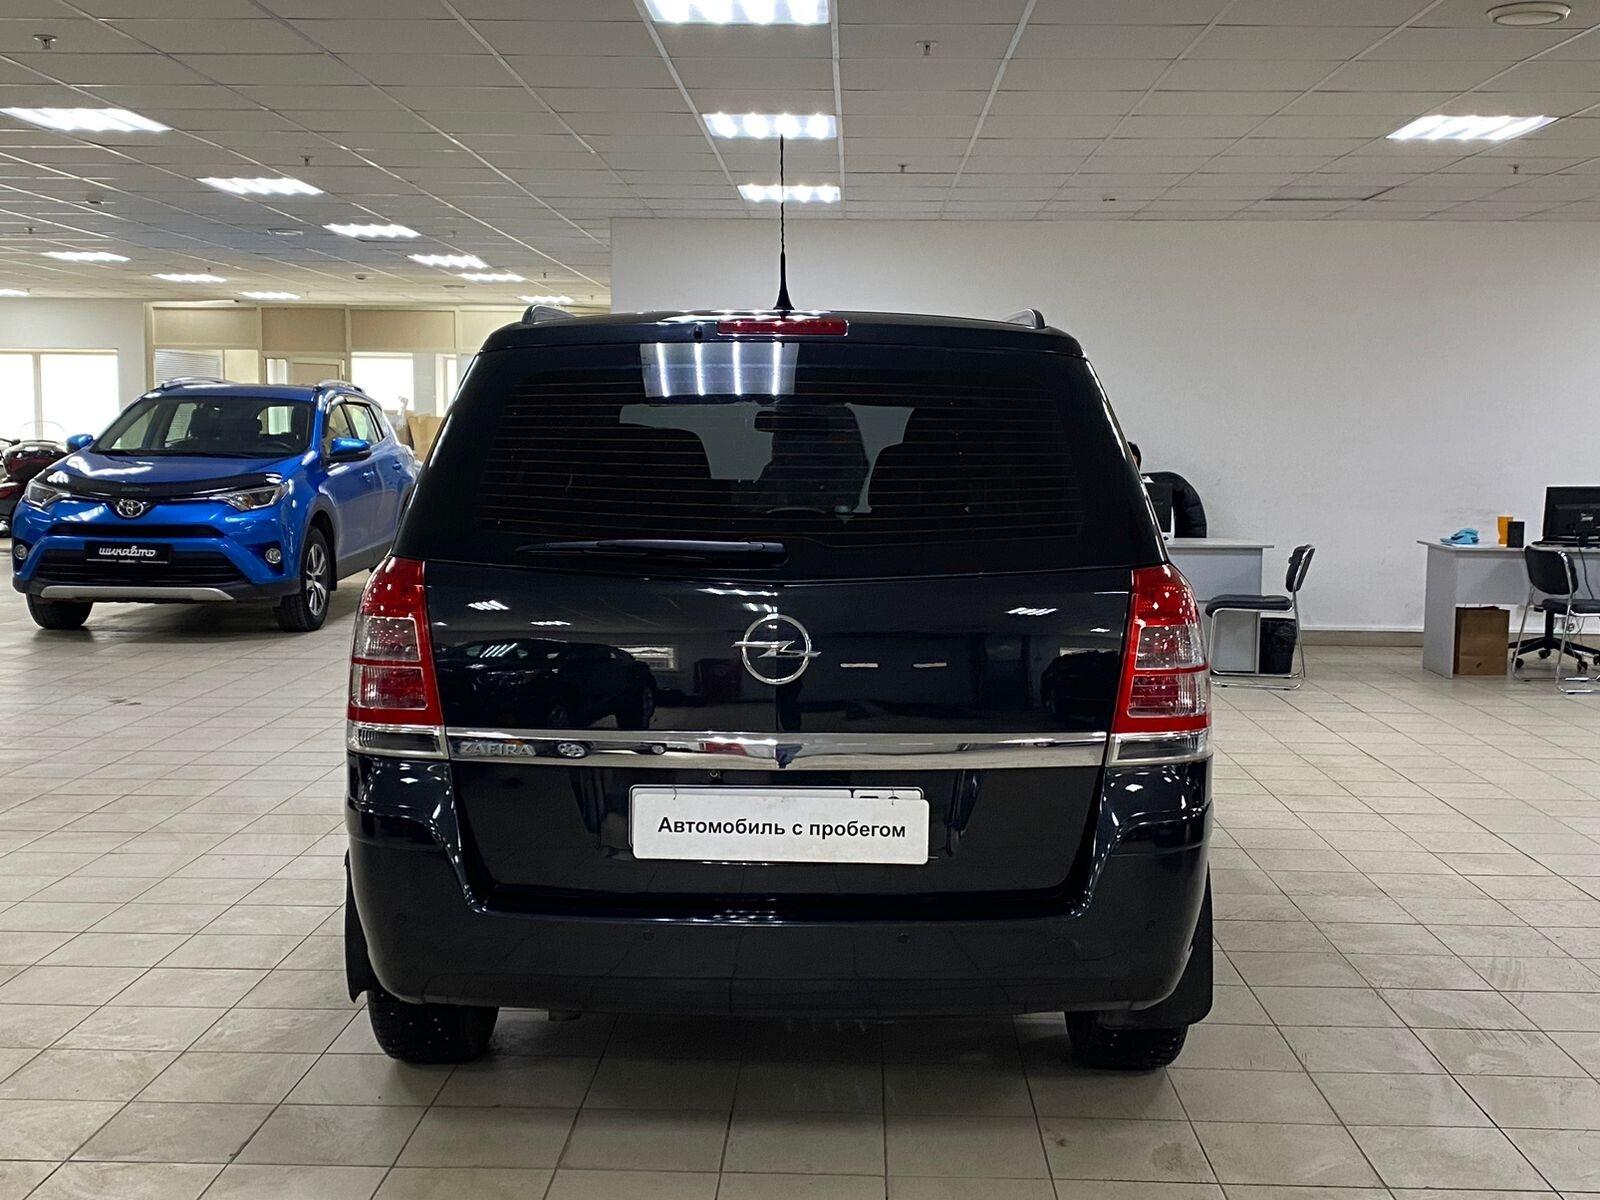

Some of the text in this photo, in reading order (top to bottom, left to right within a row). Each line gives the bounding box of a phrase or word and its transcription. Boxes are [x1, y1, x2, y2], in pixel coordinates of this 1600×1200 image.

[460, 741, 536, 755] ZAFIRA
[657, 816, 906, 839] Автомобиль с пробегом
